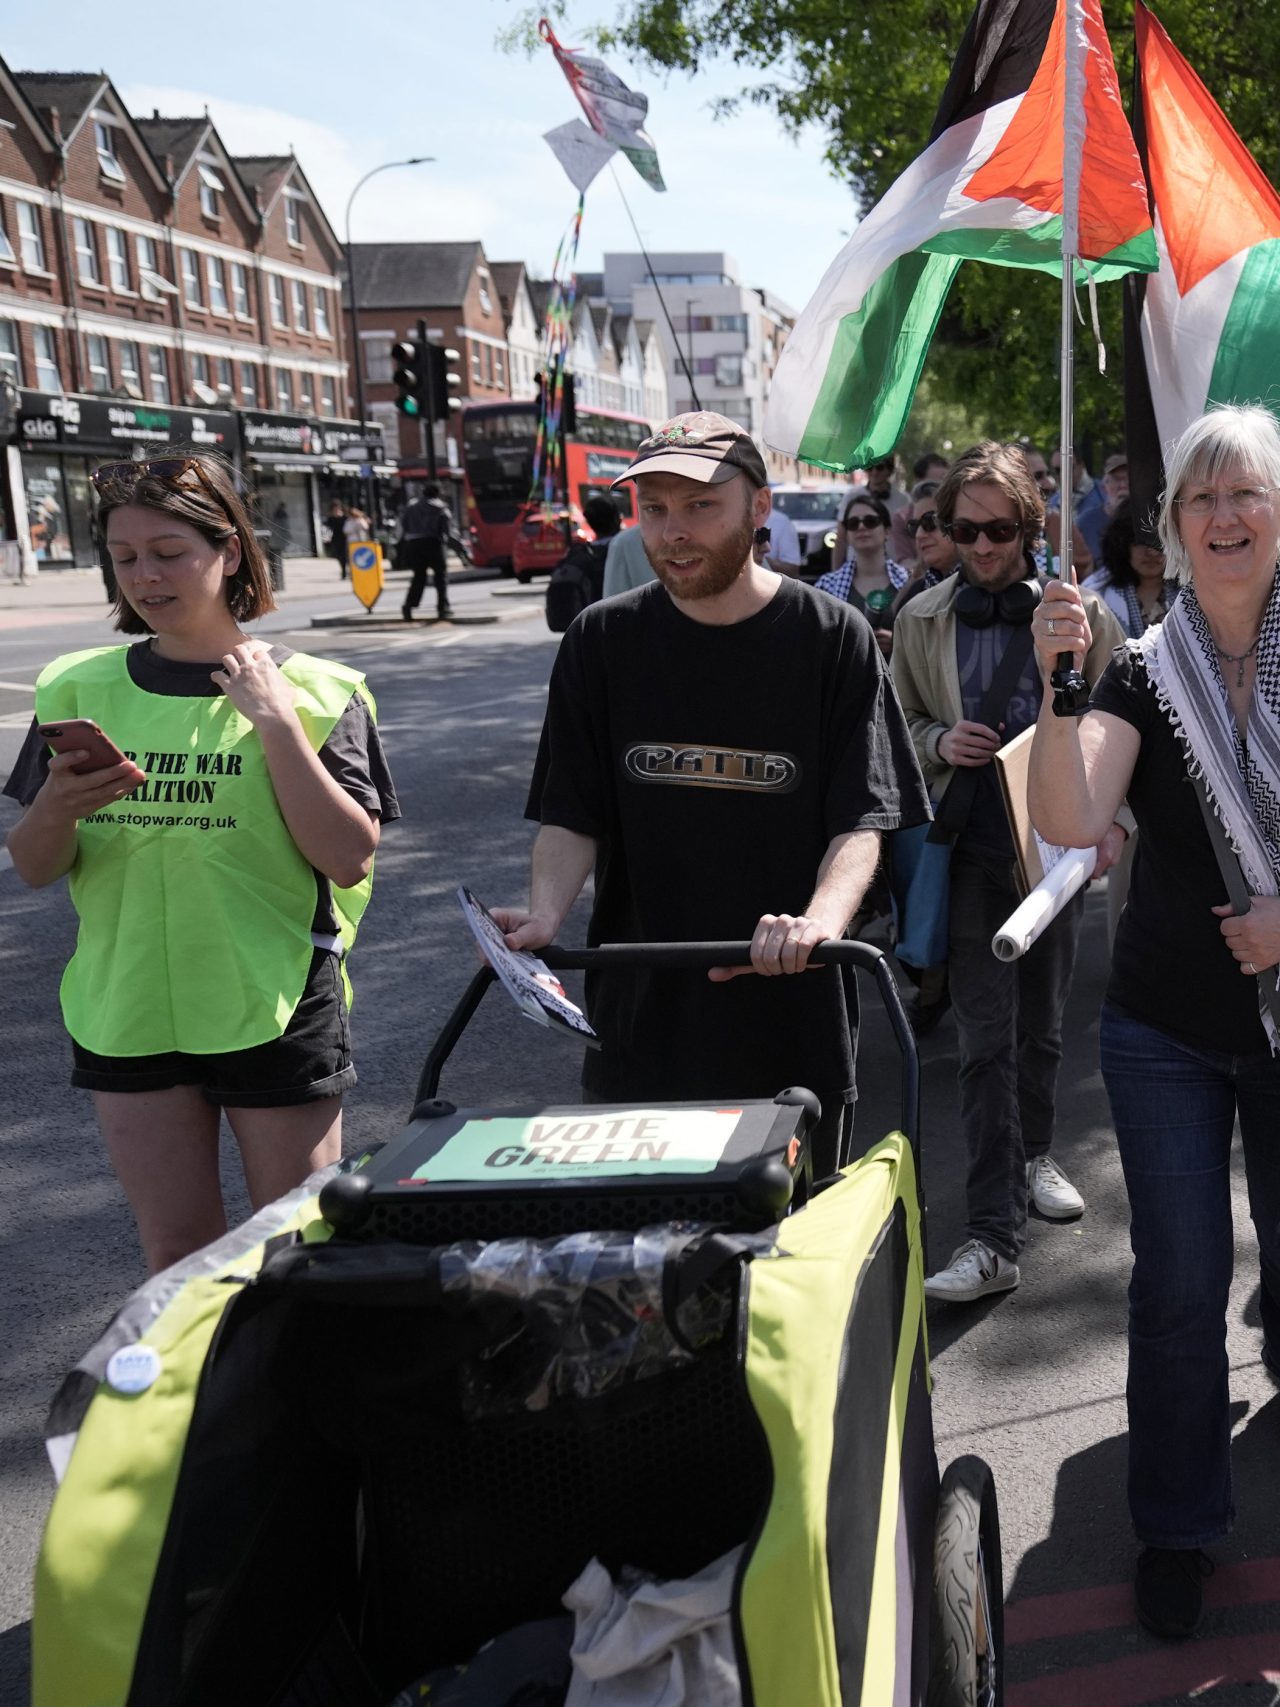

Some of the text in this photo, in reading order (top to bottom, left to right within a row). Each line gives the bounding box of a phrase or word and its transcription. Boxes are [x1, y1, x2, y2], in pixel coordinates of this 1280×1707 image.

[144, 752, 189, 774] THE
[196, 753, 243, 776] WAR
[635, 745, 793, 784] PATTA
[124, 779, 217, 804] ALITION
[529, 1117, 669, 1144] VOTE
[483, 1140, 670, 1168] GREEN
